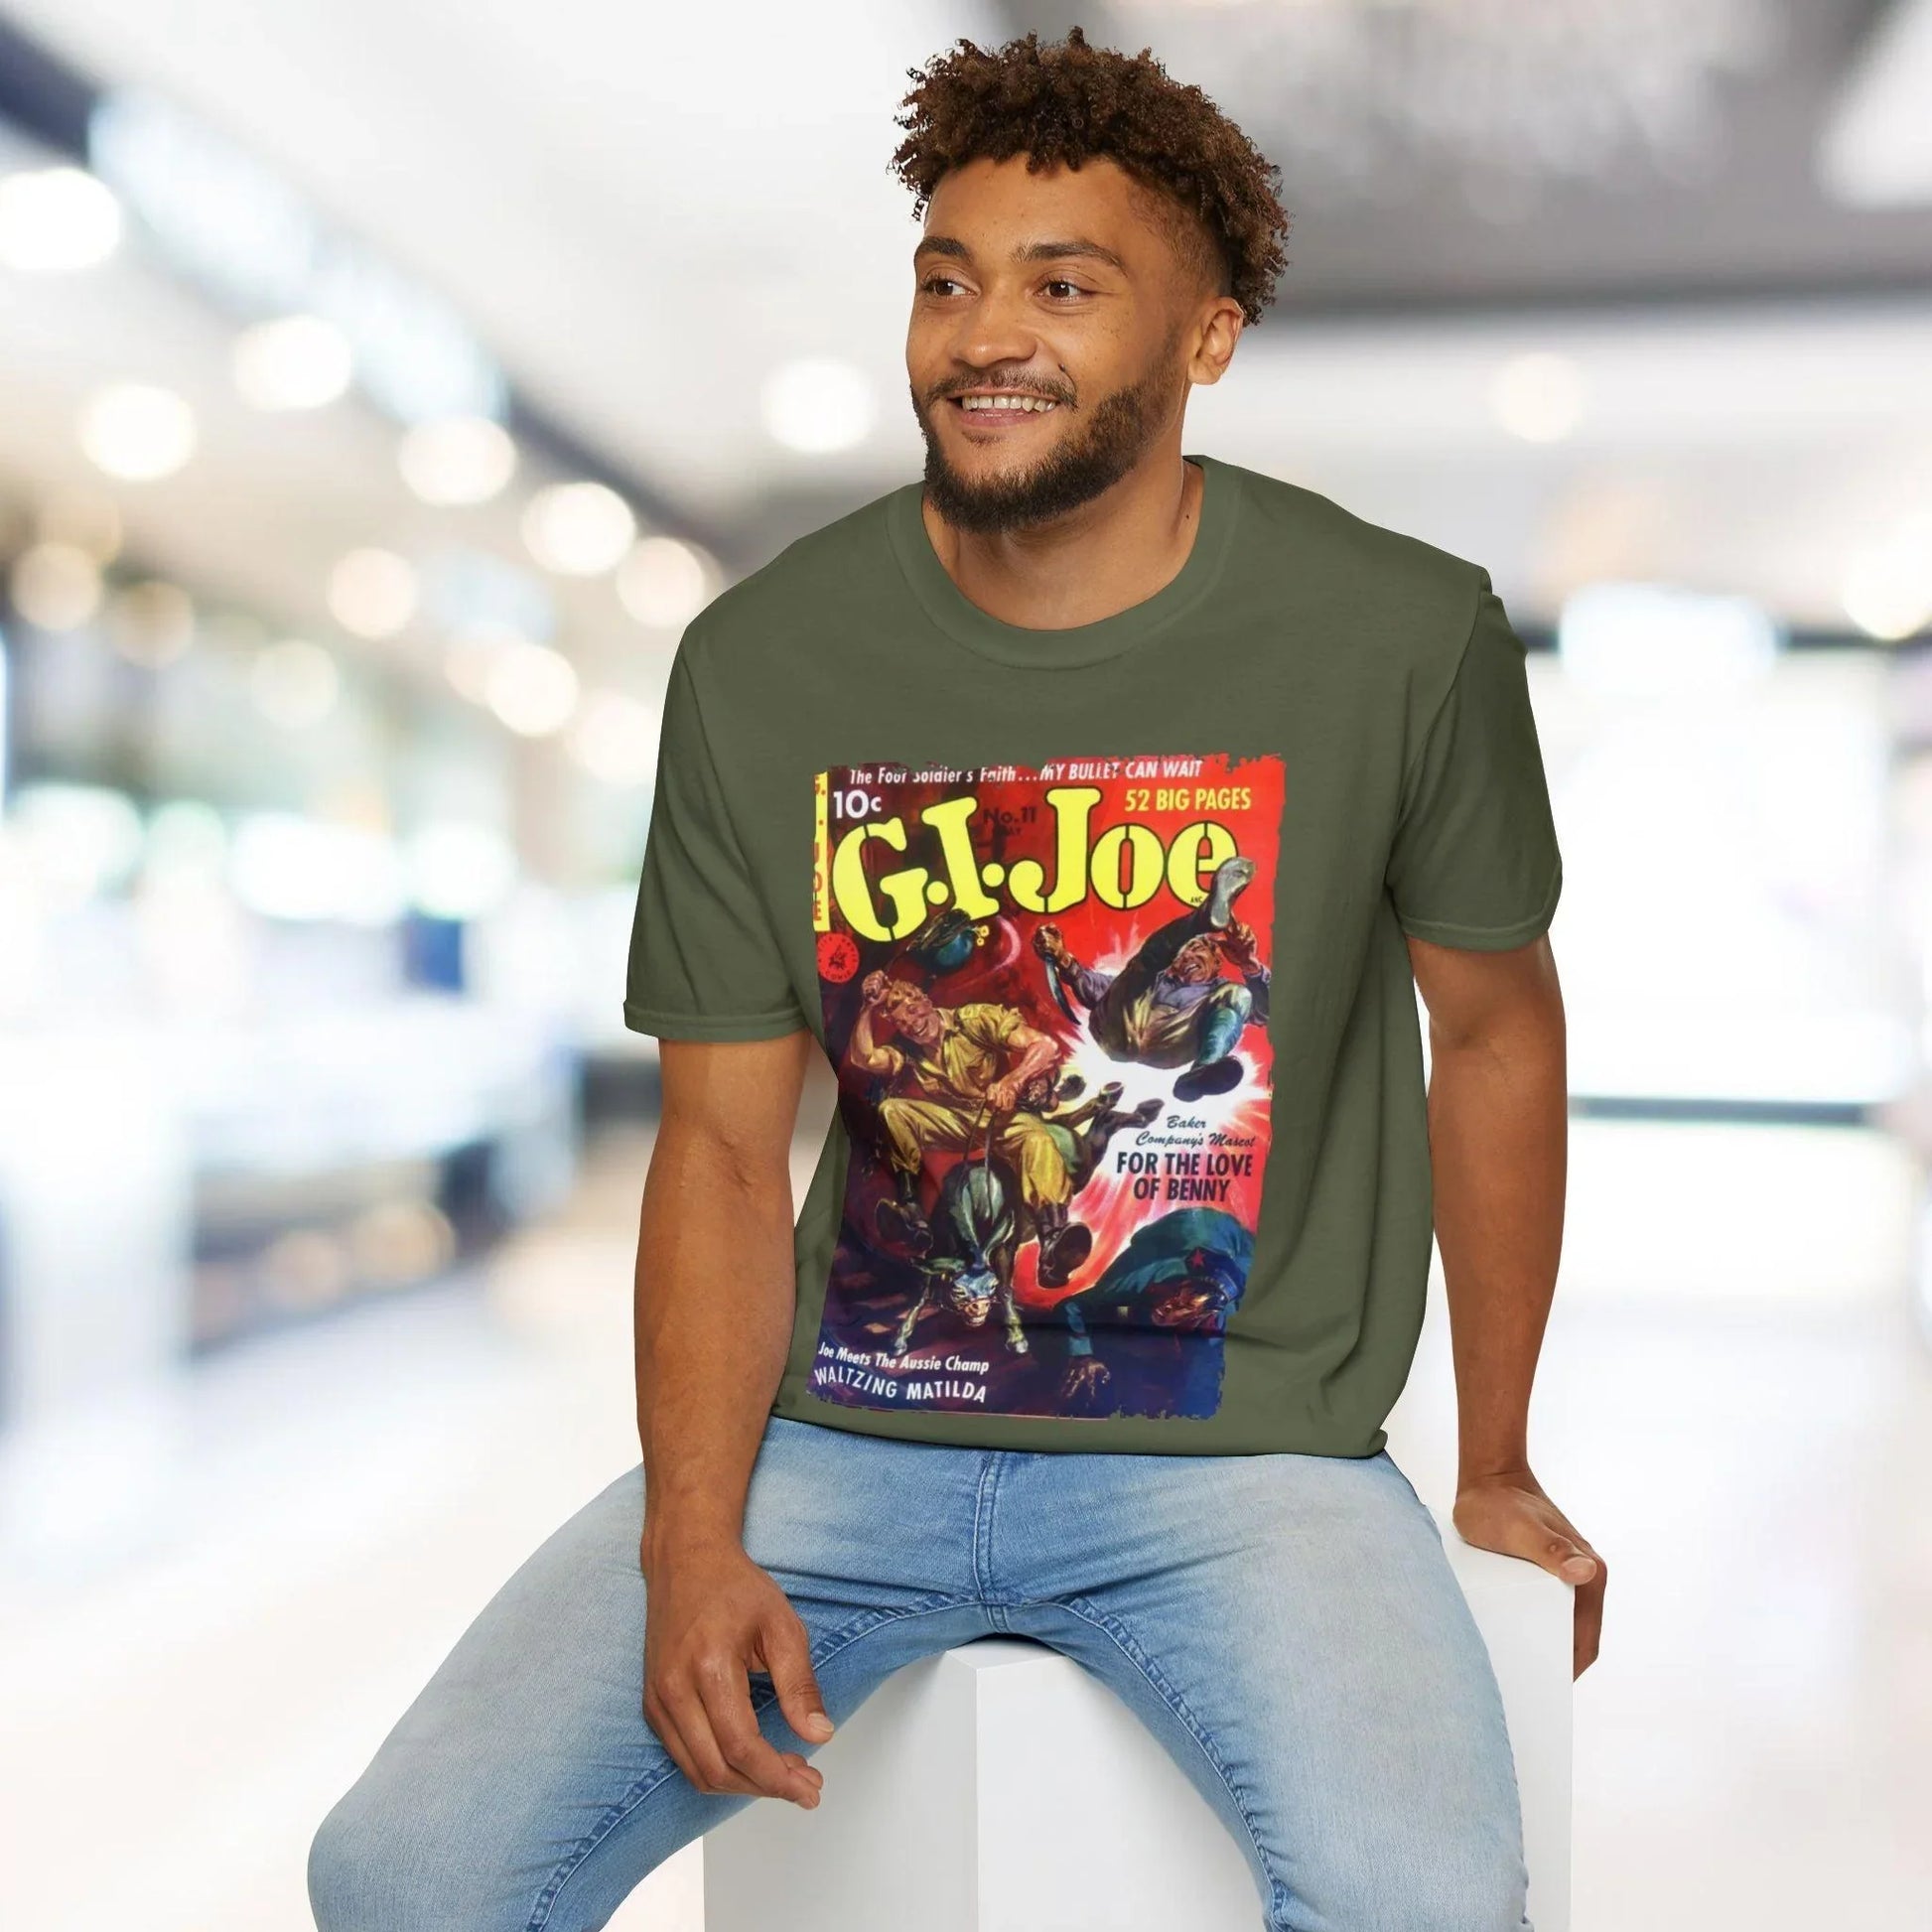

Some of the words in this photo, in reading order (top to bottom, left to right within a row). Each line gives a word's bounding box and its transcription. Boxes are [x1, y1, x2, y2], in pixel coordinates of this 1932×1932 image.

[850, 768, 873, 784] The
[1068, 761, 1120, 780] BULLET
[1125, 760, 1160, 778] CAN
[1163, 759, 1203, 777] WAIT
[1125, 789, 1150, 811] 52
[1156, 788, 1190, 811] BIG
[1194, 787, 1251, 810] PAGES
[1167, 1115, 1207, 1129] Baker
[1135, 1131, 1204, 1148] Company's
[1117, 1152, 1159, 1173] FOR
[1165, 1154, 1200, 1174] THE
[1206, 1154, 1253, 1176] LOVE
[1134, 1178, 1160, 1199] OF
[1167, 1179, 1230, 1201] BENNY
[818, 1341, 834, 1359] Joe
[836, 1347, 871, 1365] Meets
[876, 1352, 897, 1369] The
[898, 1355, 941, 1370] Aussie
[945, 1356, 990, 1375] Champ
[814, 1366, 897, 1398] WALTZING
[905, 1381, 987, 1403] MATILDA
